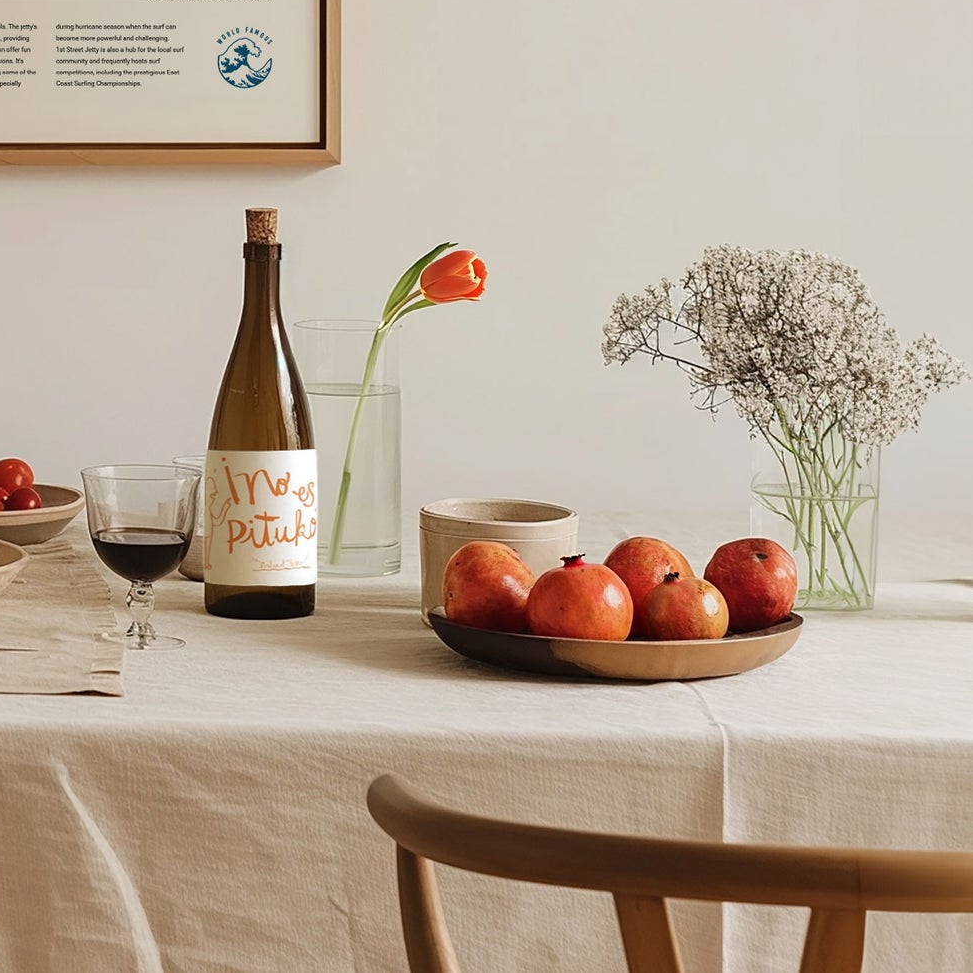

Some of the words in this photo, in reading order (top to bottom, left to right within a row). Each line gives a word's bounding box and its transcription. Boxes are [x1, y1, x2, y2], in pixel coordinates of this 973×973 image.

[20, 23, 37, 31] jetty's
[55, 23, 74, 32] during
[216, 27, 240, 45] WORLD
[245, 26, 274, 45] FAMOUS
[84, 46, 100, 54] Jetty
[101, 57, 130, 66] frequently
